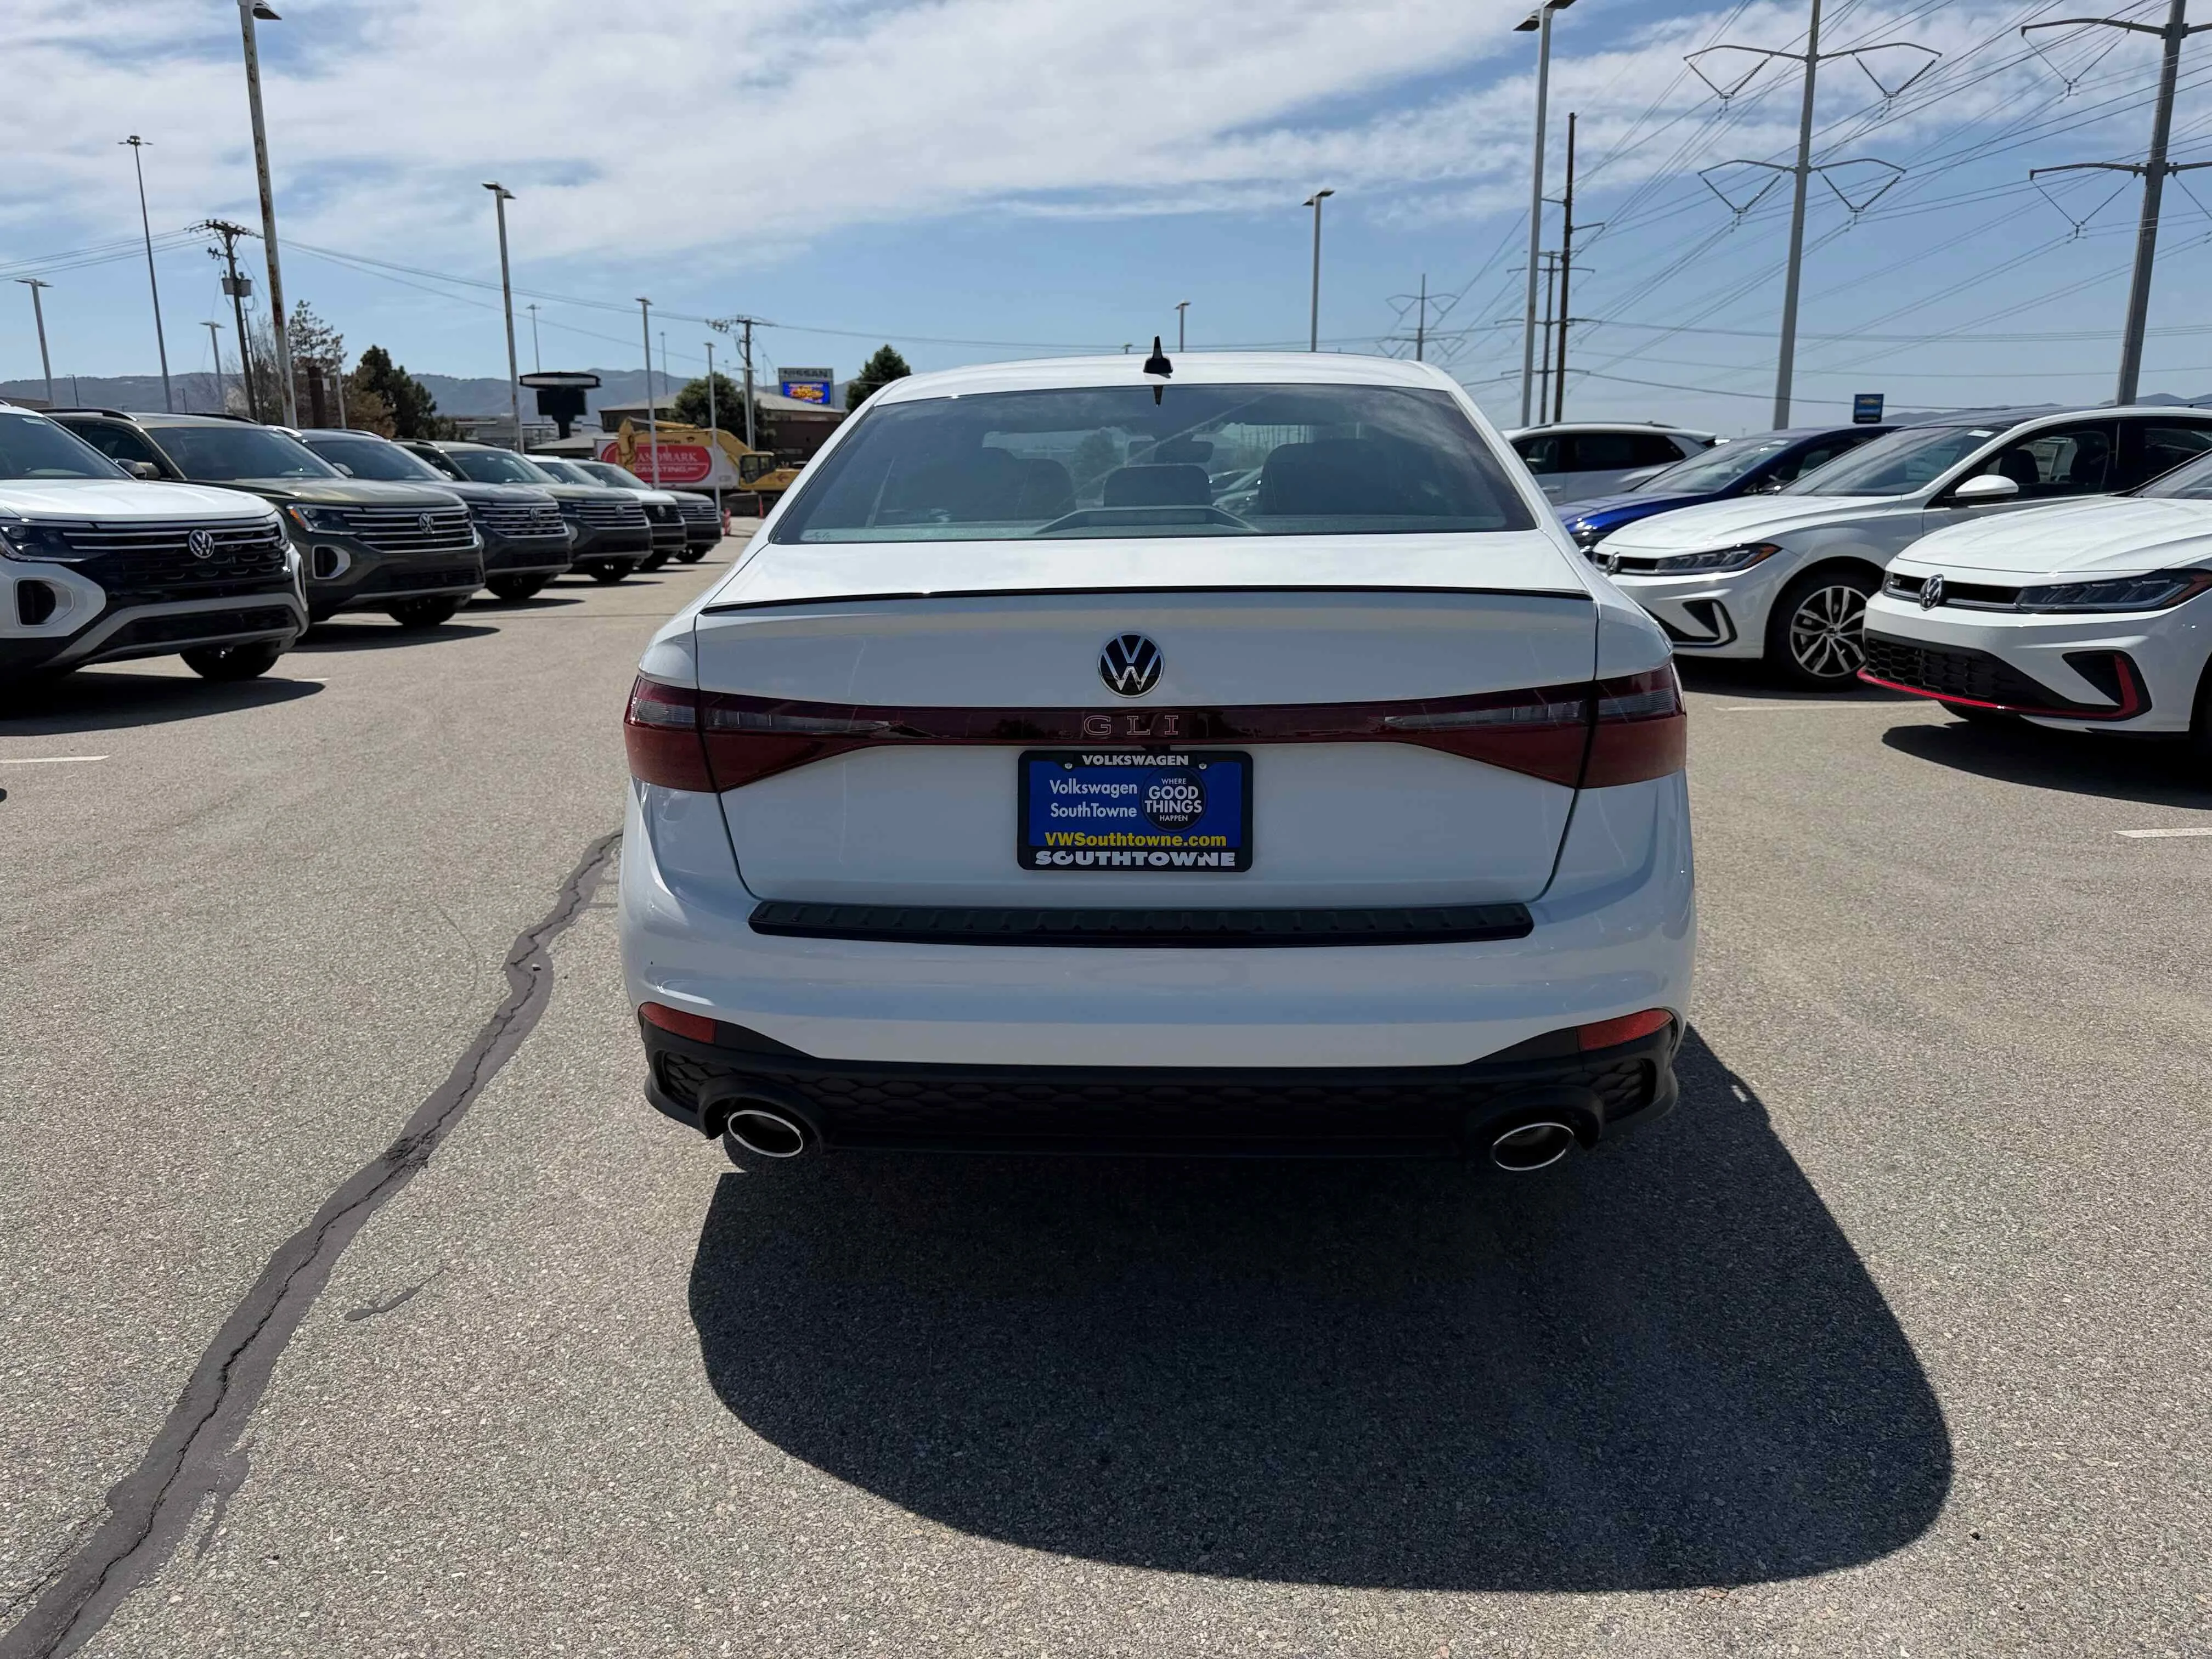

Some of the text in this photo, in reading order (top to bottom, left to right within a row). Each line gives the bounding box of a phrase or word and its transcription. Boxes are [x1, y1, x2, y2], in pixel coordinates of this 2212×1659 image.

[1084, 715, 1178, 736] GLI
[1082, 755, 1189, 765] VOLKSWAGEN
[1049, 778, 1137, 798] Volkswagen
[1148, 786, 1199, 799] GOOD
[1051, 802, 1137, 817] SouthTowne
[1144, 800, 1203, 813] THINGS
[1045, 832, 1227, 847] VWSouthtowne.com
[1035, 850, 1235, 866] SOUTHTOWNE
